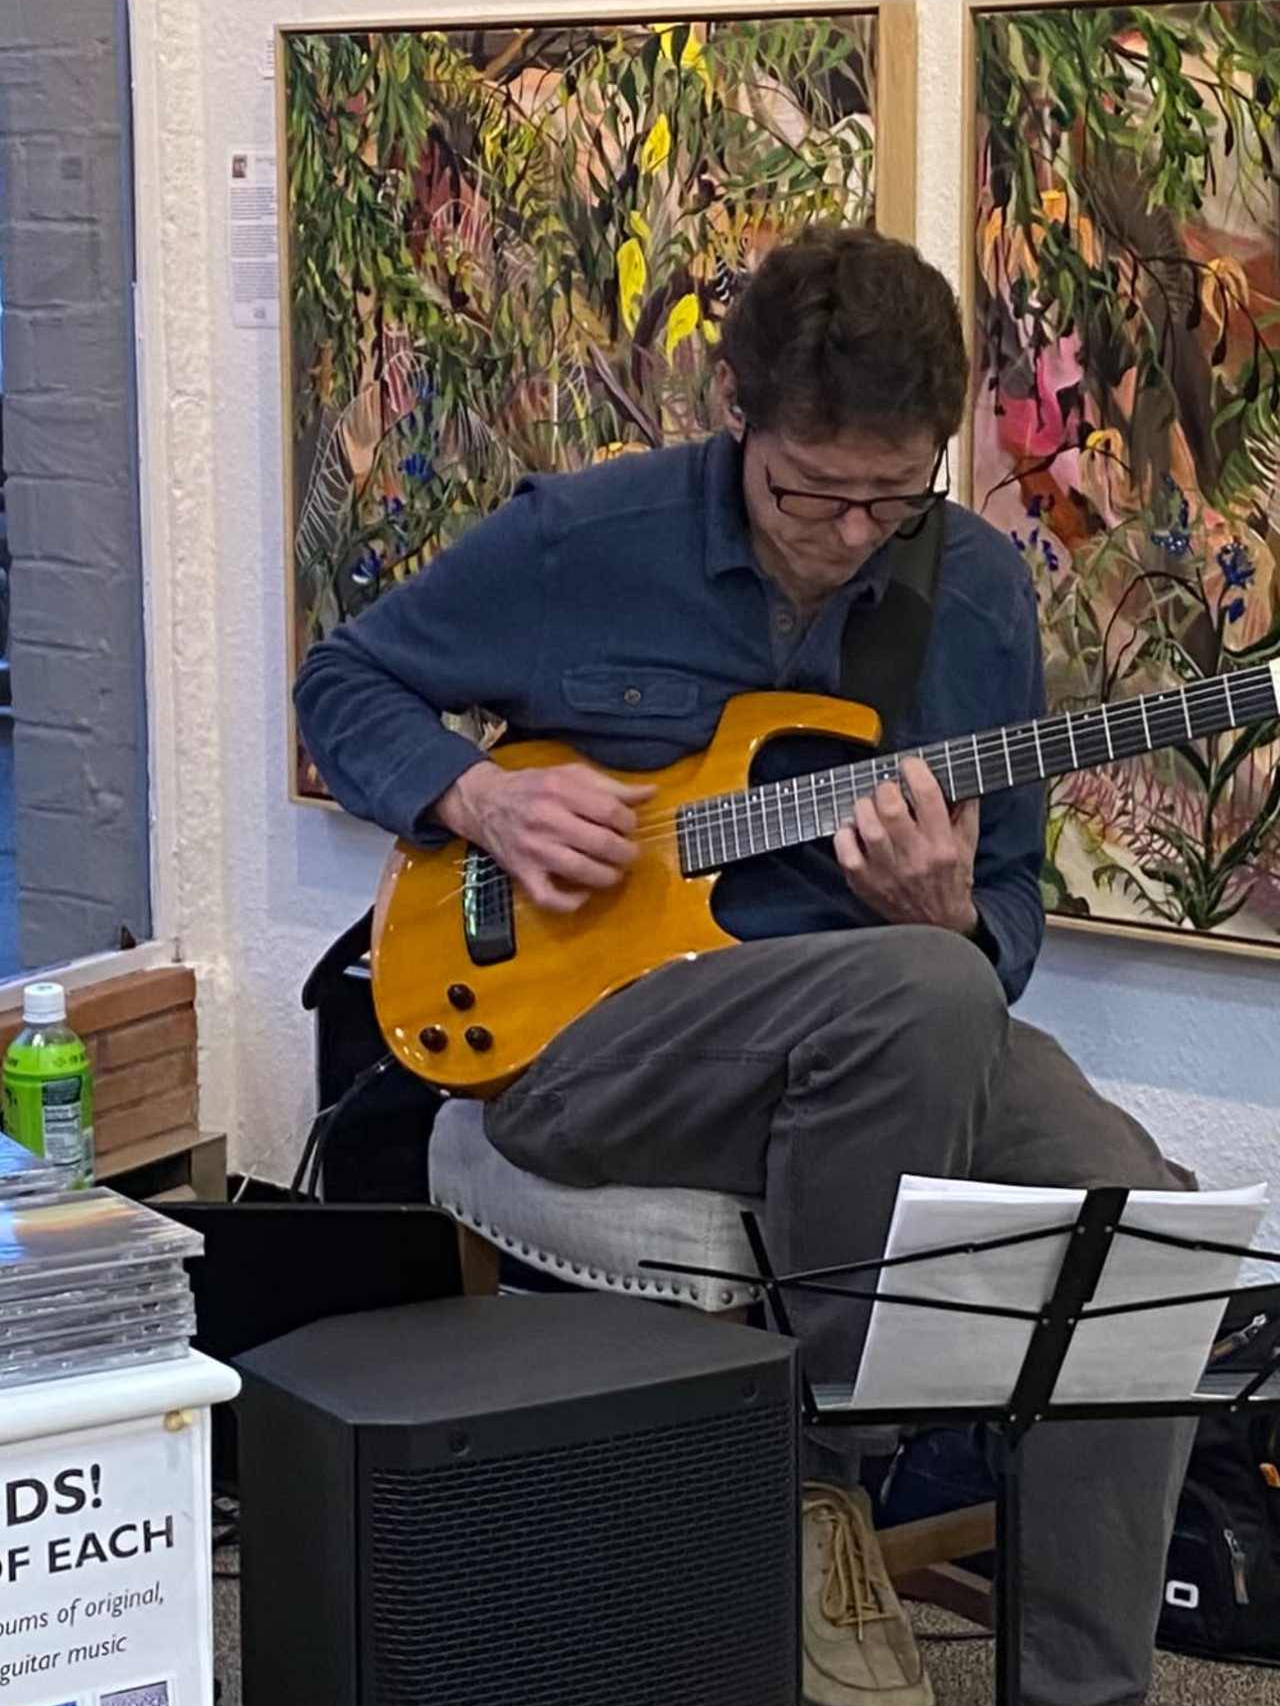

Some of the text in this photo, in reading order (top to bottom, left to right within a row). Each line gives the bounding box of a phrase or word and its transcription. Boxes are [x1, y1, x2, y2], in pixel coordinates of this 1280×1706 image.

[48, 1515, 175, 1573] EACH
[57, 1600, 82, 1629] of
[84, 1582, 166, 1620] original,
[0, 1650, 62, 1686] guitar
[68, 1634, 128, 1666] music
